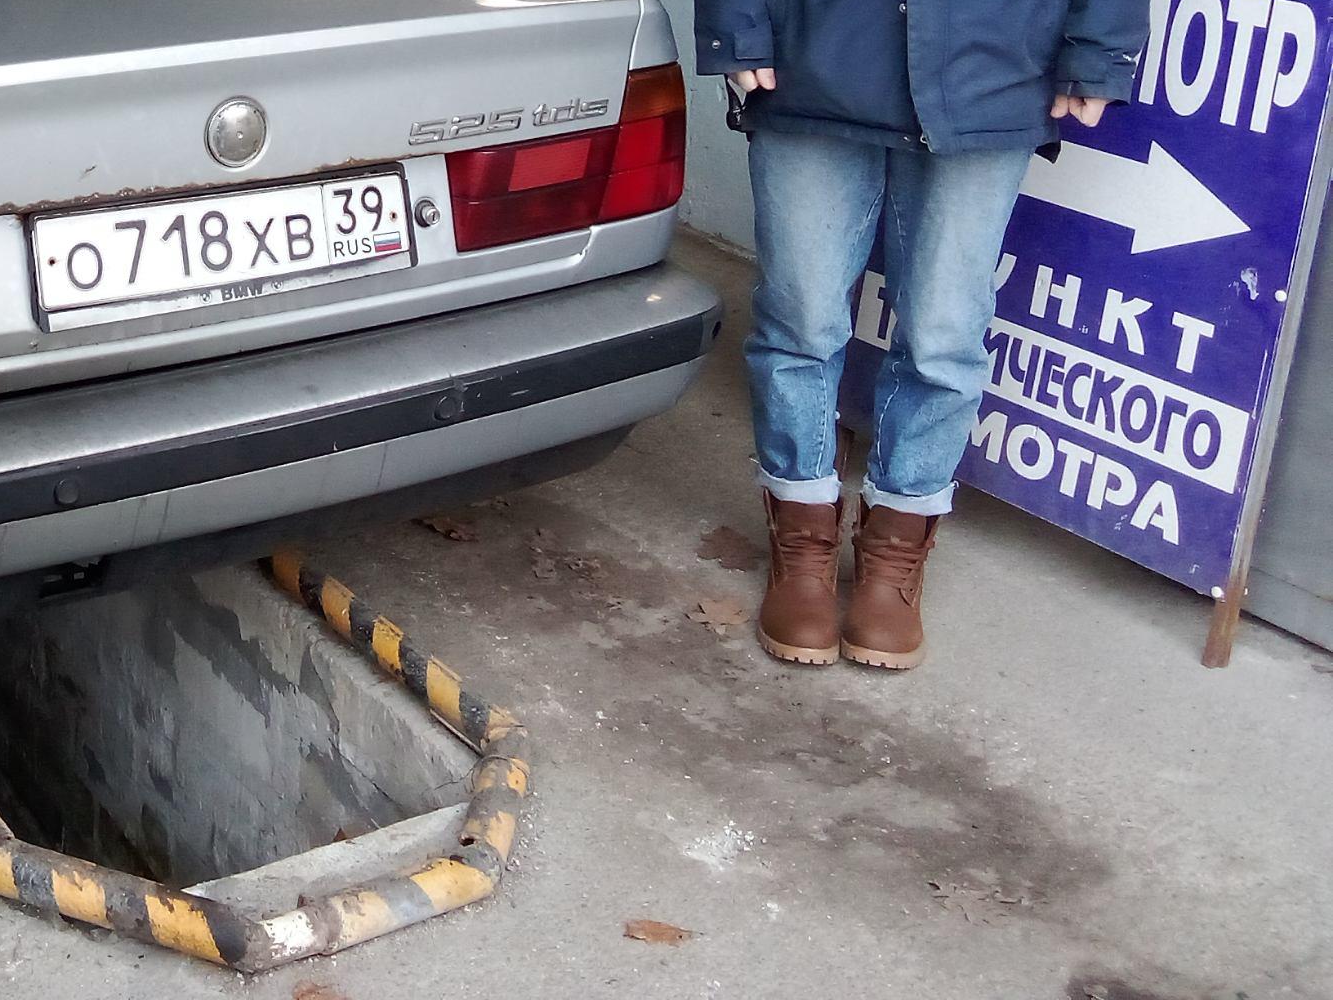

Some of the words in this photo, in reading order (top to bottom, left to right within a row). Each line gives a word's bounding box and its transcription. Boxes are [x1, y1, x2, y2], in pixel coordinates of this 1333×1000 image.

[408, 107, 524, 146] 525
[532, 97, 610, 127] tds
[333, 185, 383, 235] 39
[333, 237, 373, 258] RUS
[221, 281, 265, 302] BMW
[983, 327, 1222, 470] ИЧЕСКОГО
[970, 410, 1179, 546] МОТРА
